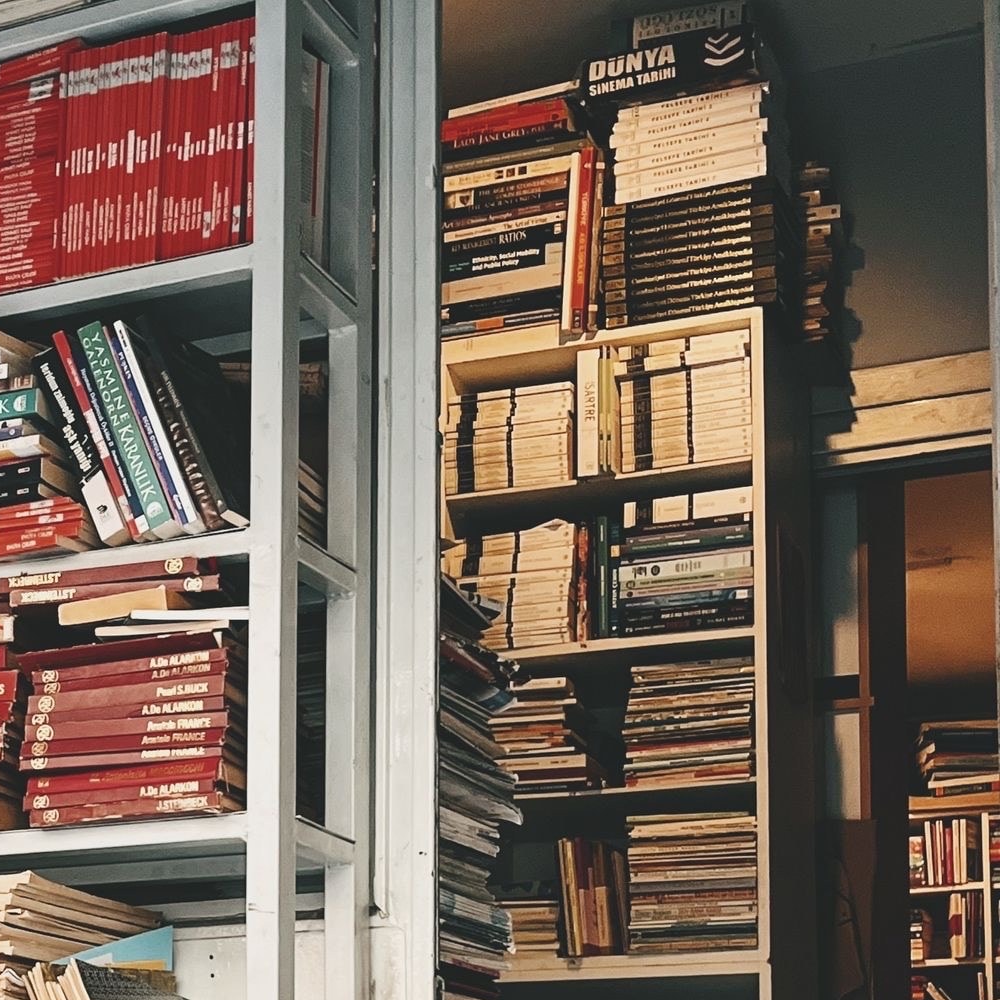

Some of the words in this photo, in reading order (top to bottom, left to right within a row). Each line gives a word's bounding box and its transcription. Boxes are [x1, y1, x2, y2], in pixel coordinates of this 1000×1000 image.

[589, 45, 675, 82] DÜNYA
[500, 230, 526, 244] RATIOS
[82, 338, 121, 426] GALENORN
[92, 332, 129, 421] YASMINE
[120, 424, 156, 502] KARANLIK
[170, 652, 210, 666] ALARKON
[176, 683, 208, 694] S.BUCK
[162, 700, 204, 713] ALARKON
[177, 718, 212, 728] FRANCE
[159, 782, 198, 795] ALARKON
